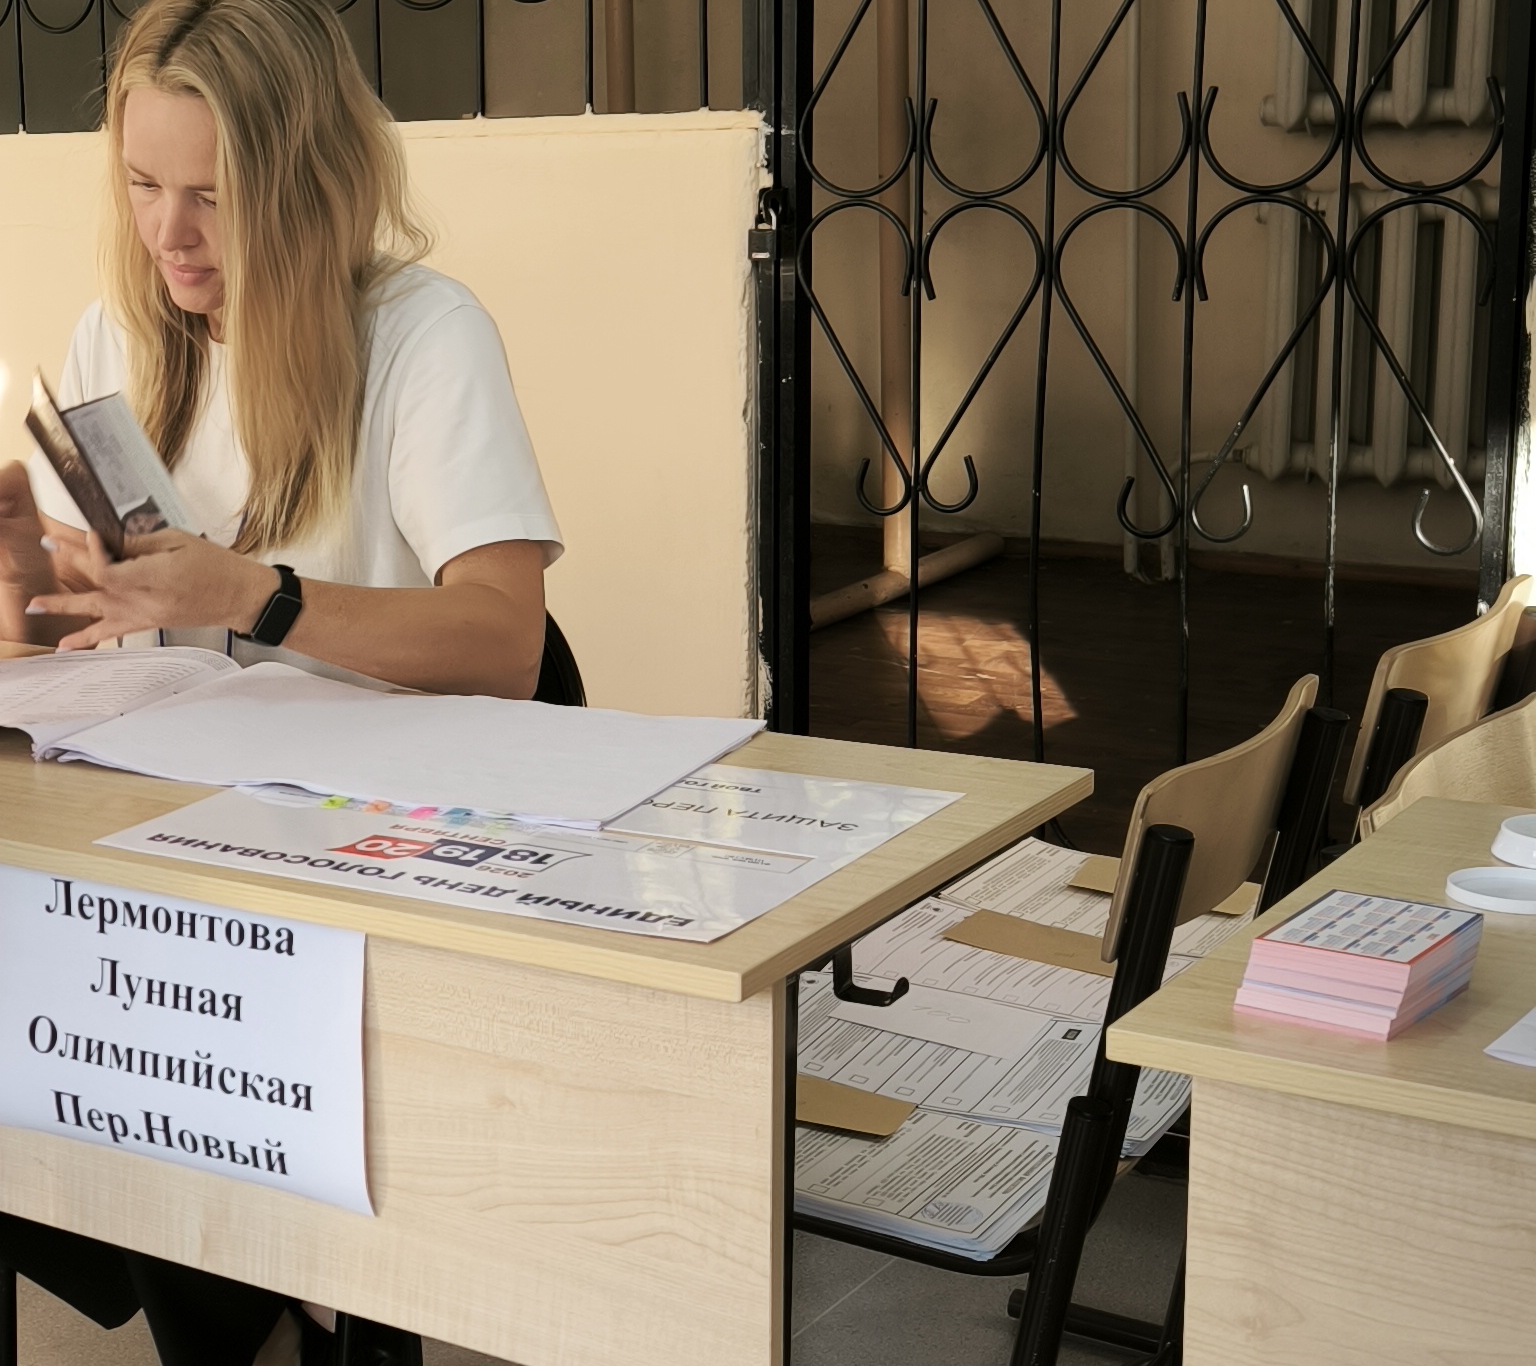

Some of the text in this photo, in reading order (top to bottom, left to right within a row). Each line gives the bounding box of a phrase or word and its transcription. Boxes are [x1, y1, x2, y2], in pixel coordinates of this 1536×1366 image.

[354, 838, 550, 865] 18 19 20
[388, 823, 506, 846] СЕНТЯБРЯ
[726, 808, 860, 832] ЗАЩИТА
[45, 877, 296, 958] Лермонтова
[146, 832, 695, 928] ЕДИНЫЙ ДЕНЬ ГОЛОСОВАНИЯ
[89, 955, 244, 1024] Лунная
[28, 1013, 314, 1113] Олимпийская
[50, 1088, 290, 1176] Пер.Новый
